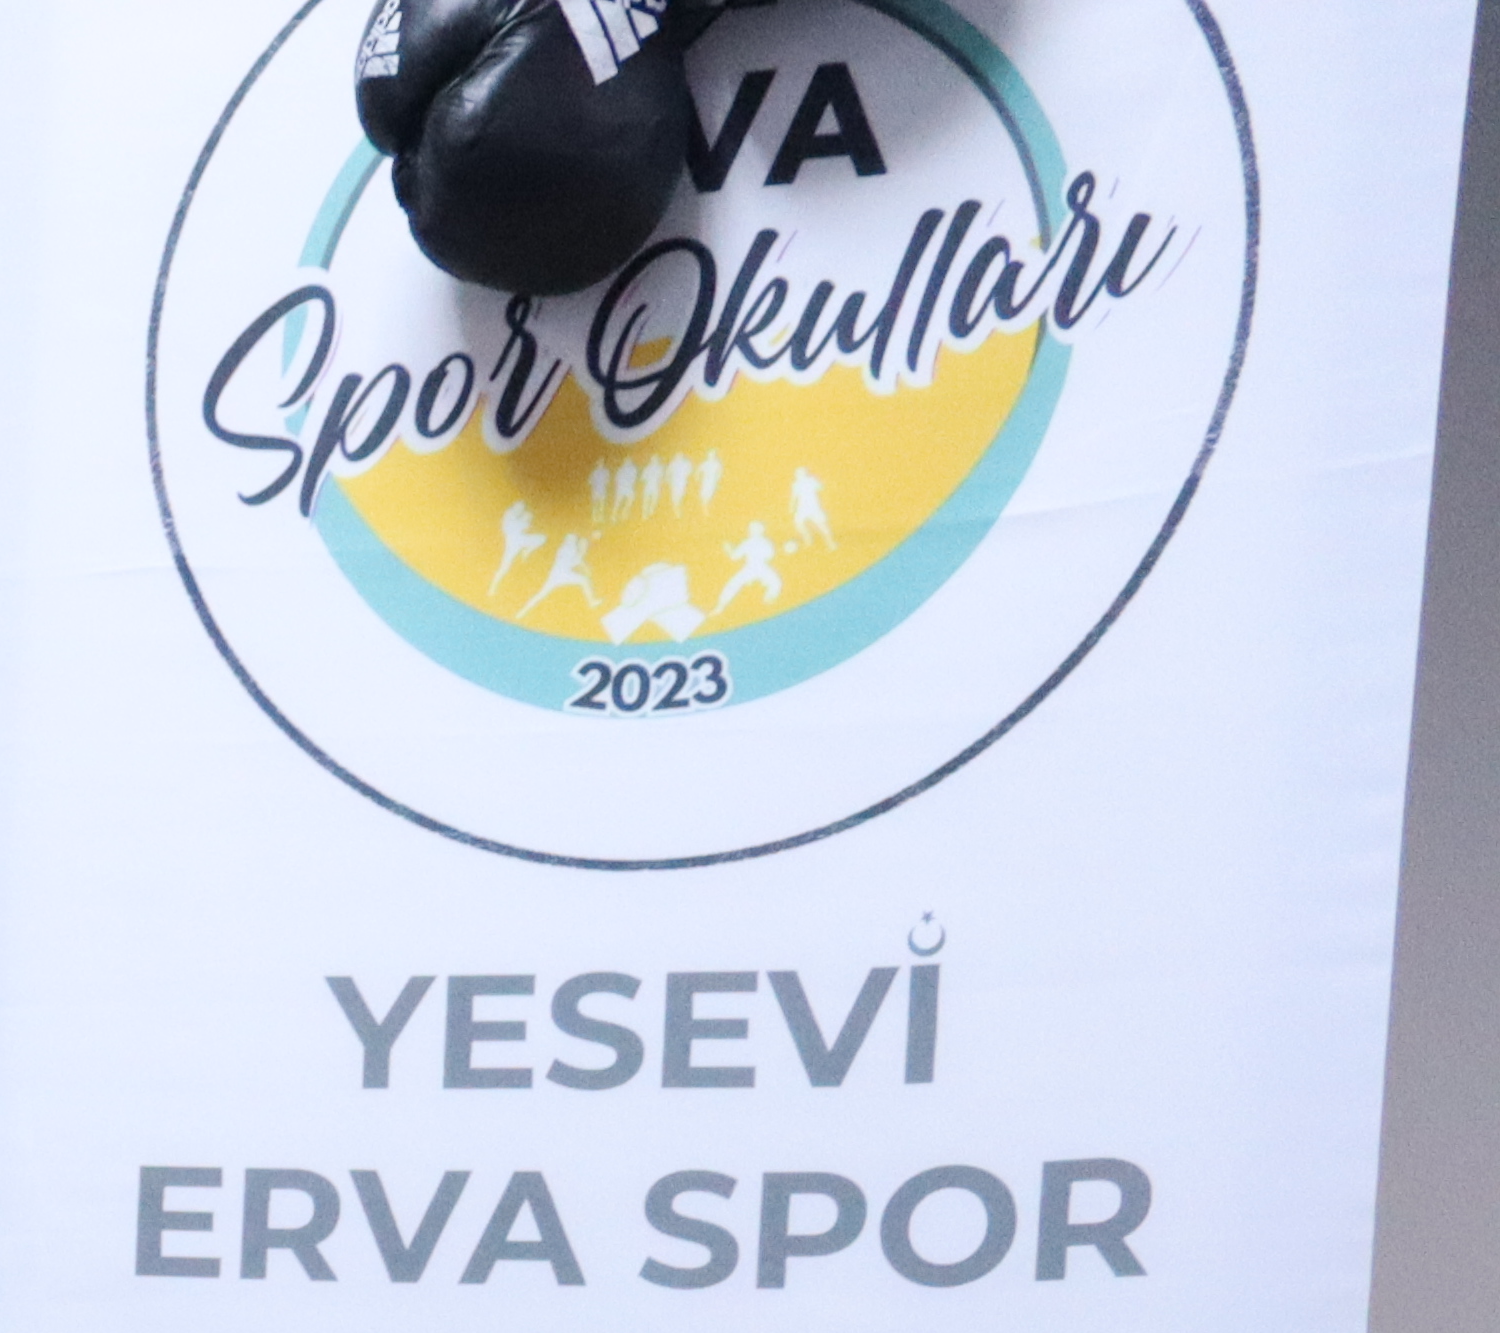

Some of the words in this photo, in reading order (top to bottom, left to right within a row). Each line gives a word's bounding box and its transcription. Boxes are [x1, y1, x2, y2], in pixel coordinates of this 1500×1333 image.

[683, 60, 888, 193] VA
[202, 285, 564, 518] Spor
[586, 170, 1176, 430] Okulları
[574, 655, 729, 713] 2023
[324, 912, 941, 1091] YESEVİ
[134, 1164, 588, 1288] ERVA
[638, 1156, 1153, 1290] SPOR
